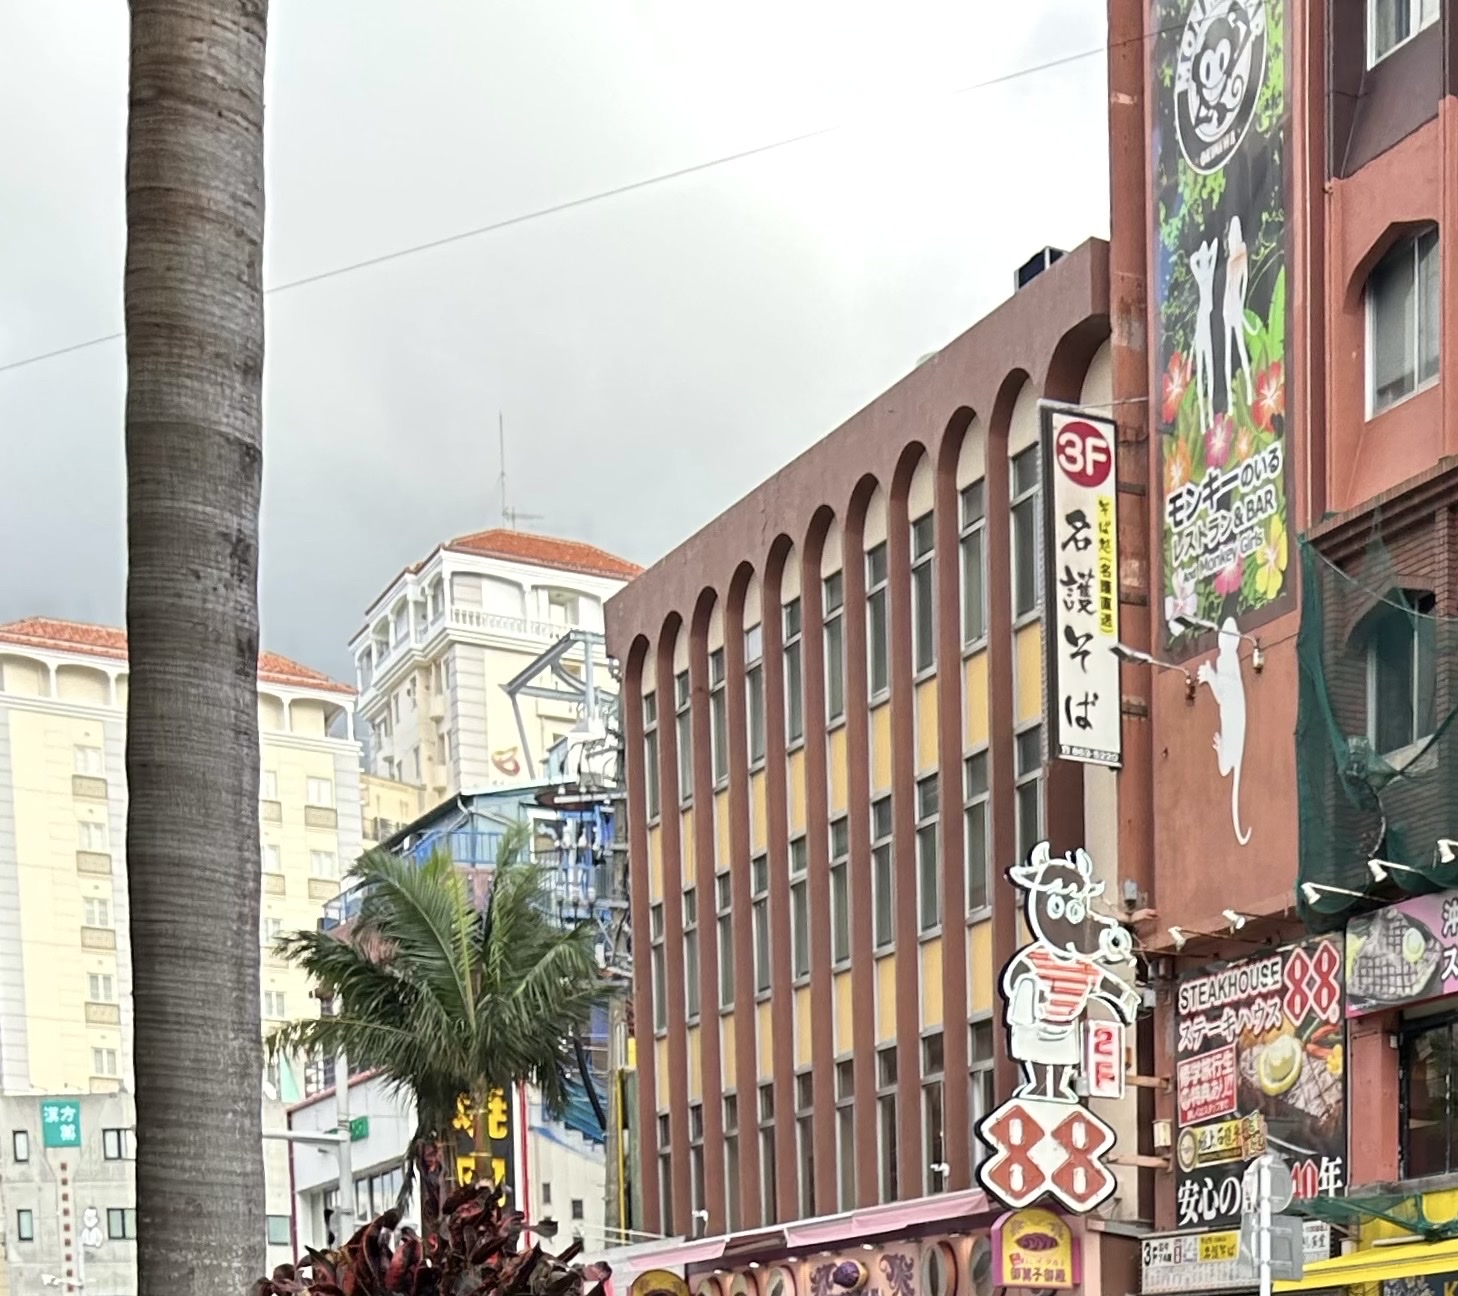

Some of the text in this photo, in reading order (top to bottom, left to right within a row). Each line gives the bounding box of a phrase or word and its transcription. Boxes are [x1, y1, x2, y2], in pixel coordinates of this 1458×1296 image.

[1058, 433, 1107, 476] 3F
[1168, 447, 1281, 528] モンキーのいる
[1060, 509, 1099, 732] 名護そば
[1284, 941, 1340, 1027] 88
[1094, 1027, 1116, 1088] 2F
[1178, 998, 1282, 1052] ステーキハウス
[987, 1105, 1110, 1201] 88
